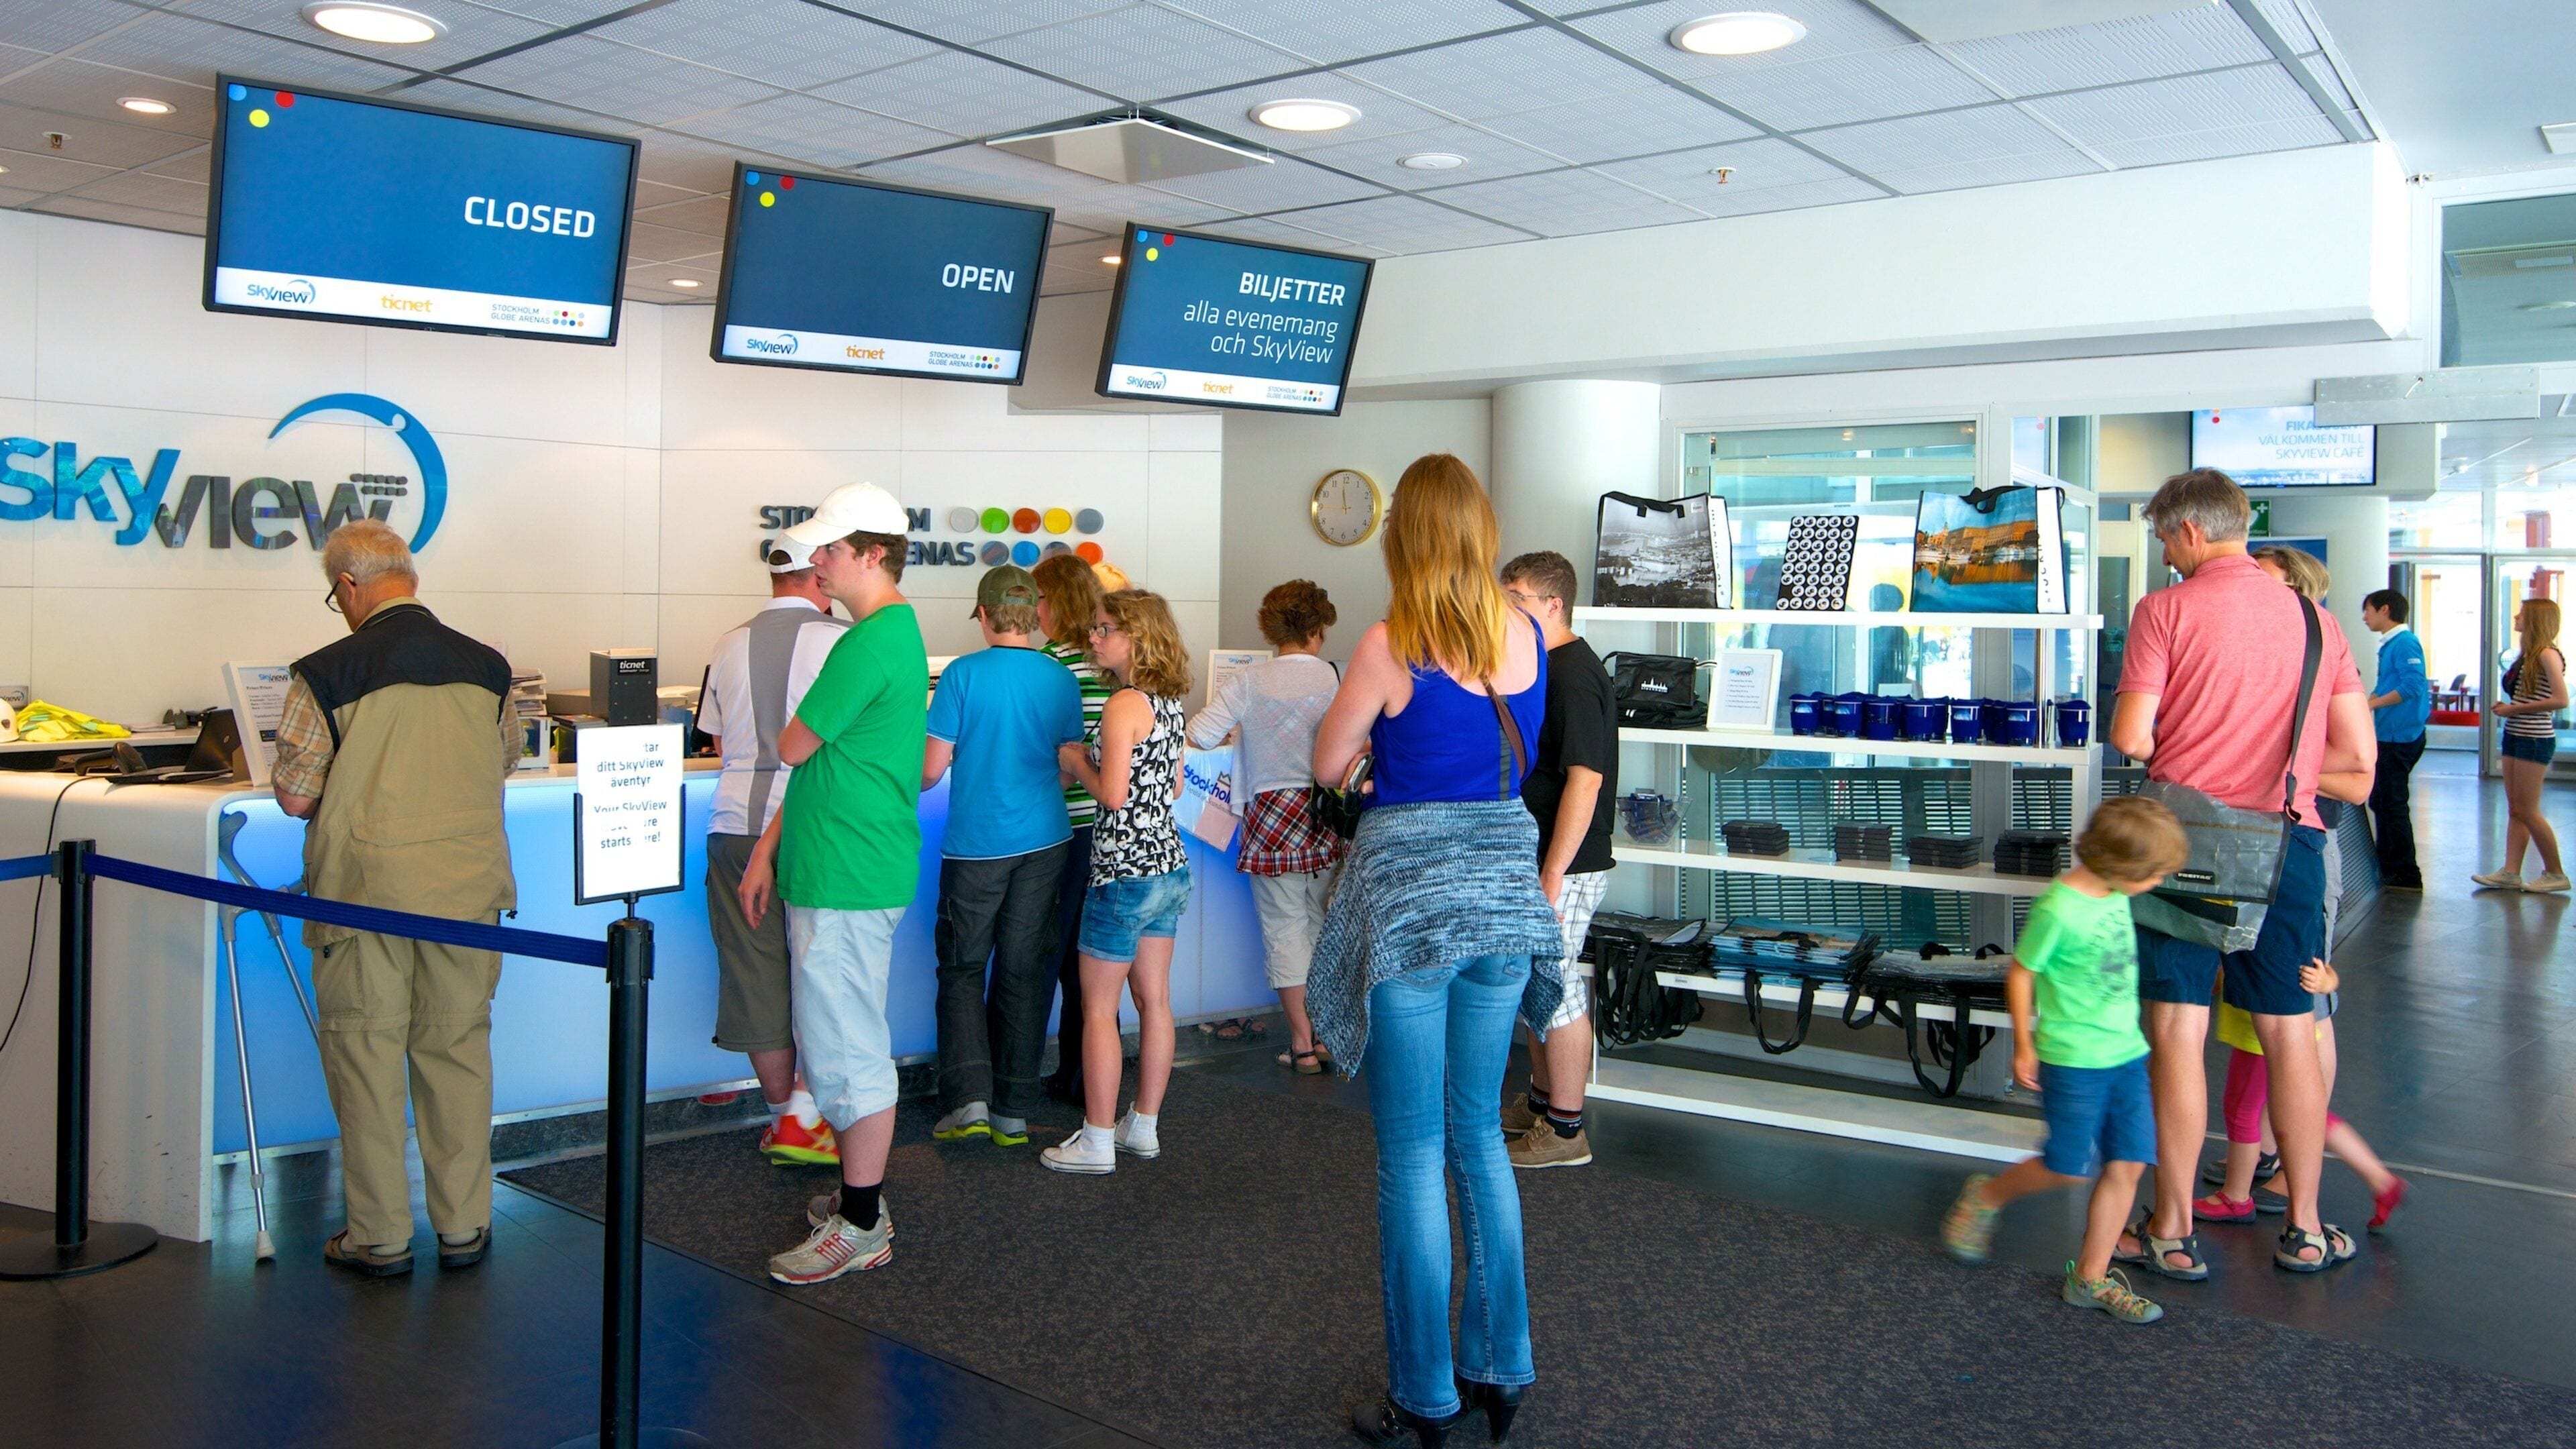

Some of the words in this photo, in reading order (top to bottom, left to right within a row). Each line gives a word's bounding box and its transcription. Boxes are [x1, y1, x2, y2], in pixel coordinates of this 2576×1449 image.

[464, 196, 595, 238] CLOSED
[942, 263, 1015, 293] OPEN
[1239, 272, 1346, 306] BILJETTER
[381, 294, 433, 313] ticnet
[492, 304, 539, 314] STOCKHOLM
[491, 313, 516, 321] GLOBE
[519, 315, 550, 325] ARENAS
[1183, 300, 1220, 324] alla
[1225, 309, 1339, 343] evenemang
[846, 344, 885, 360] ticnet
[1211, 332, 1246, 355] och
[1251, 335, 1334, 364] SkyView
[929, 351, 966, 360] STOCKHOLM
[1203, 380, 1234, 394] ticnet
[2339, 433, 2365, 444] TILL
[2275, 448, 2331, 460] SKYVIEW
[1342, 476, 1350, 484] 12
[1356, 480, 1360, 488] 1
[1364, 492, 1368, 500] 2
[1353, 529, 1358, 537] 5
[619, 660, 645, 669] ticnet
[597, 761, 616, 772] ditt
[619, 758, 664, 772] SkyView
[611, 775, 651, 788] äventyr
[1183, 764, 1230, 804] Stockhol
[600, 837, 631, 849] starts
